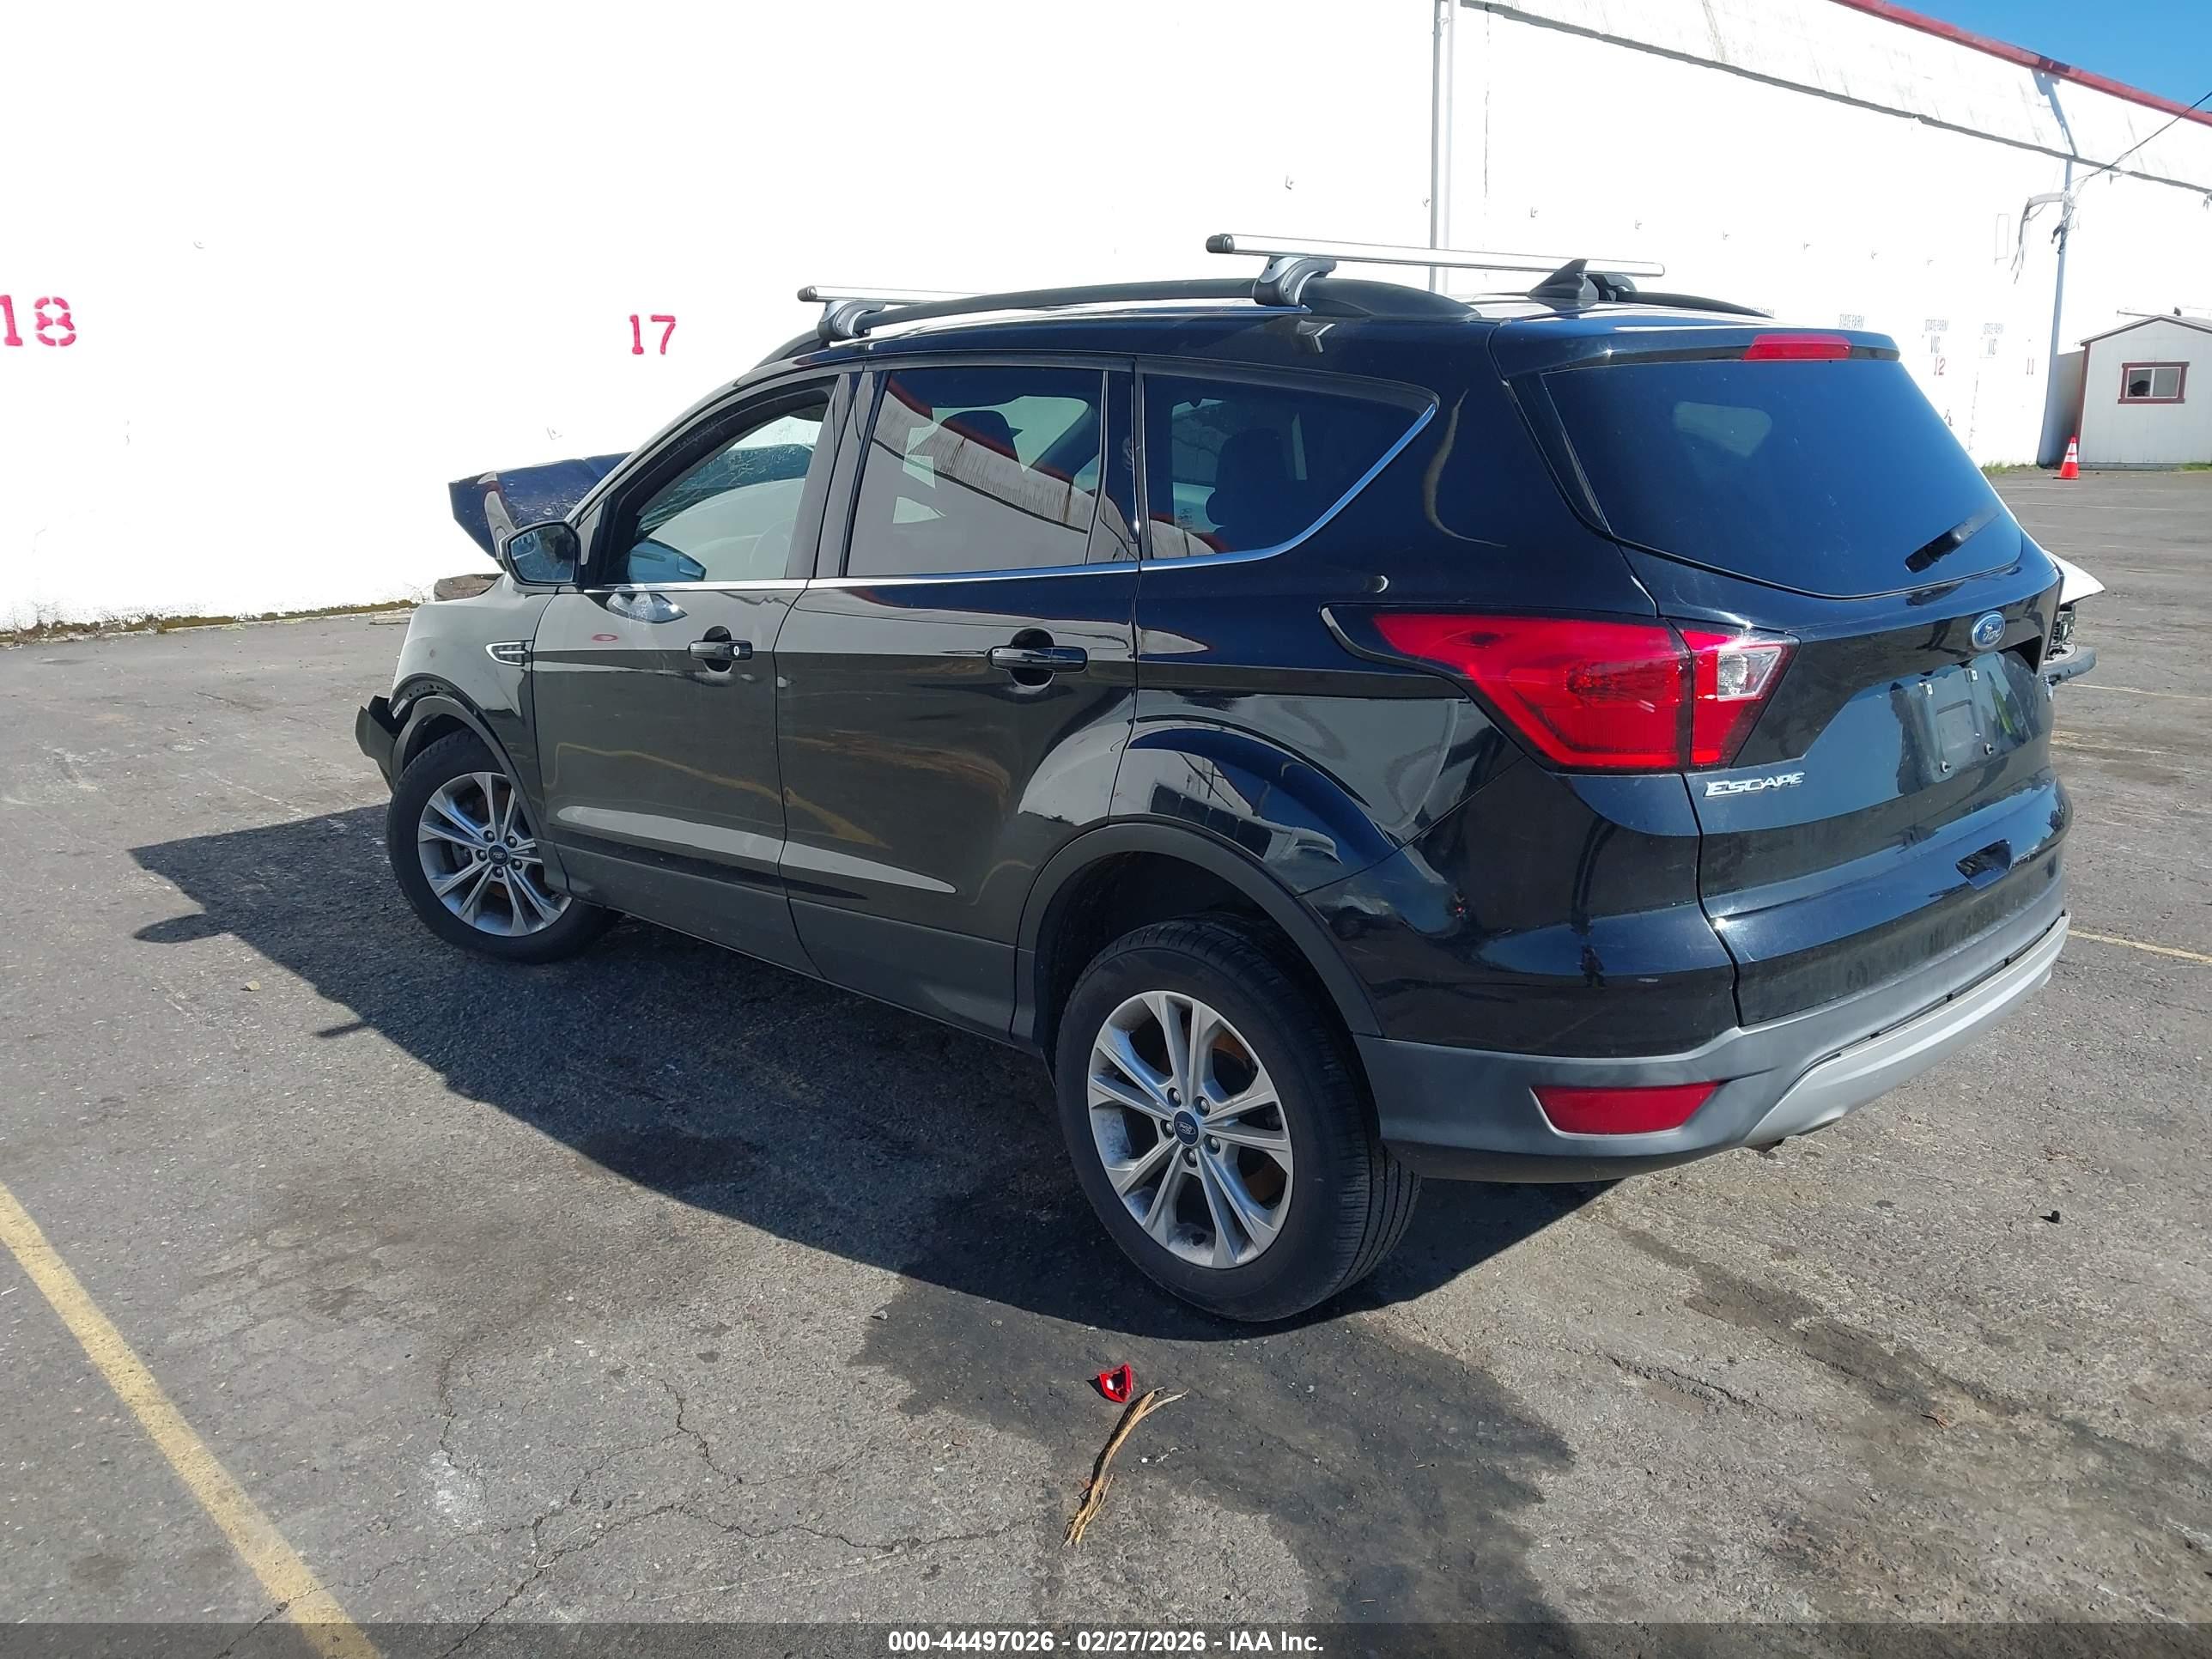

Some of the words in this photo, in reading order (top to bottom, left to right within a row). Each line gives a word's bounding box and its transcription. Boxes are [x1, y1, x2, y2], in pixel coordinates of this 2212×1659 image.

[0, 295, 76, 346] 18
[629, 314, 676, 355] 17
[1934, 356, 1946, 376] 12
[2026, 357, 2034, 375] 11
[1705, 772, 1806, 797] ESCAPE
